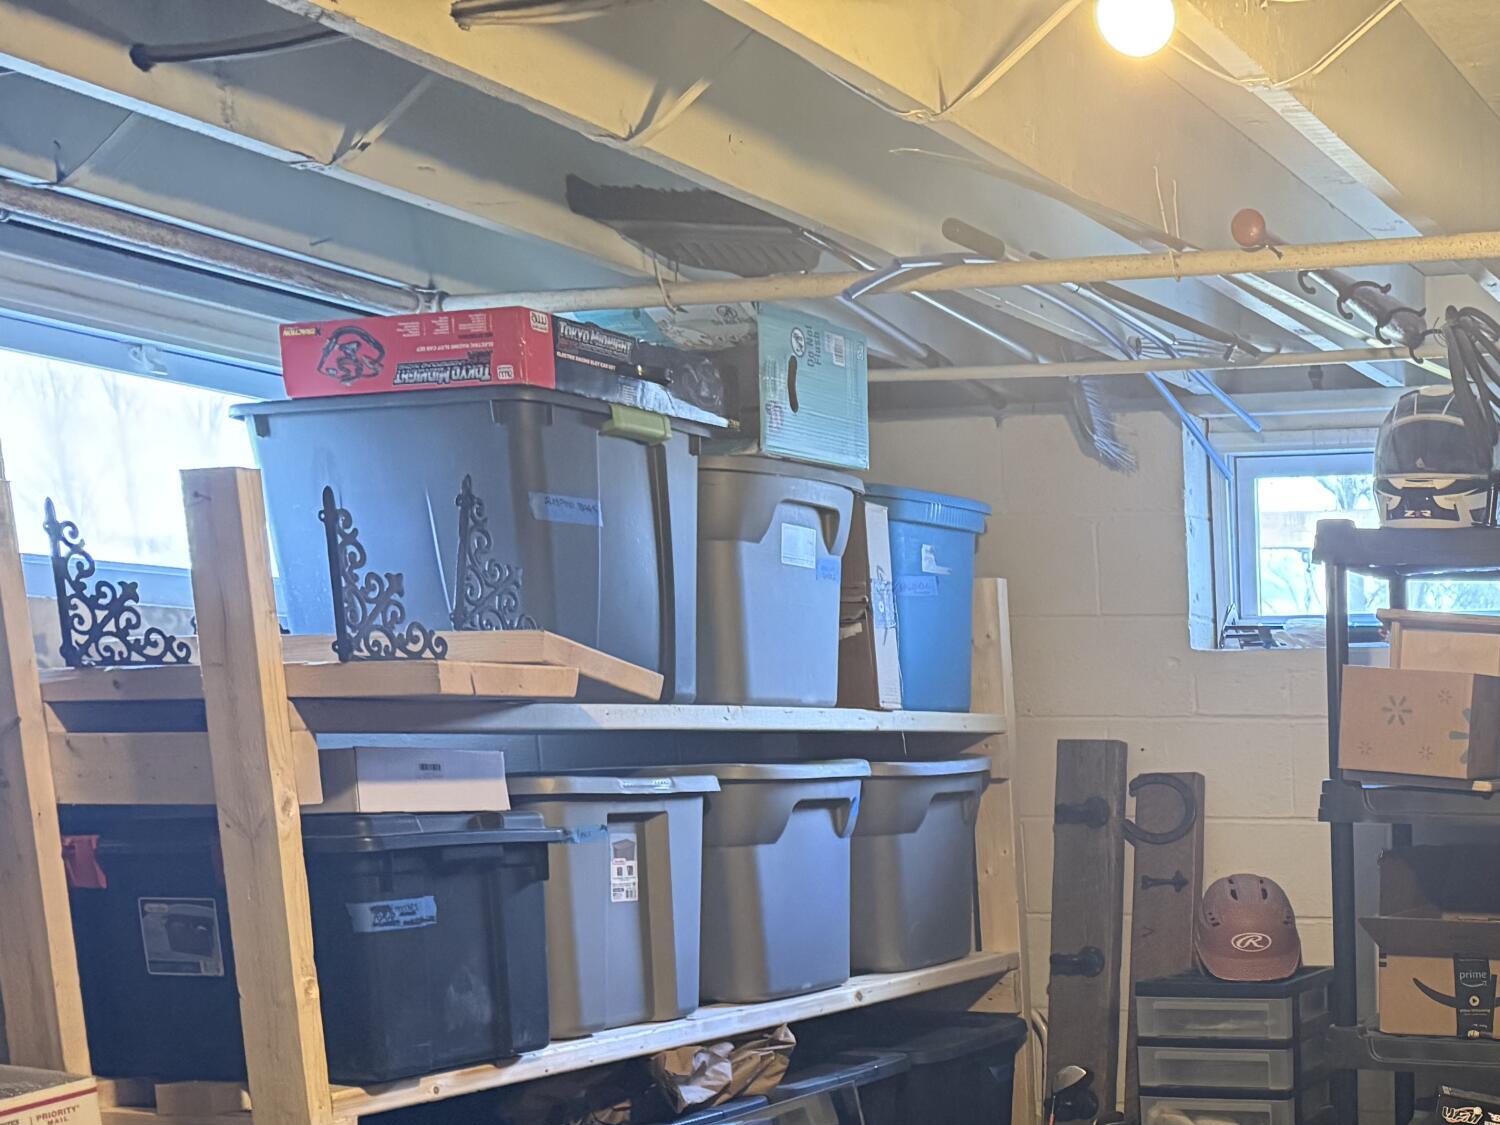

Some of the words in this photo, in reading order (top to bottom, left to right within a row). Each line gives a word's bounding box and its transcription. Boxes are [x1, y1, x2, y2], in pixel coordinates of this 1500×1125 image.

[558, 321, 590, 344] TOKYO
[590, 327, 633, 354] MIDNIGHT
[393, 362, 449, 385] MIDNIGHT
[449, 361, 492, 383] TOKYO
[1459, 971, 1488, 981] prime
[36, 1105, 77, 1122] PRIORITY
